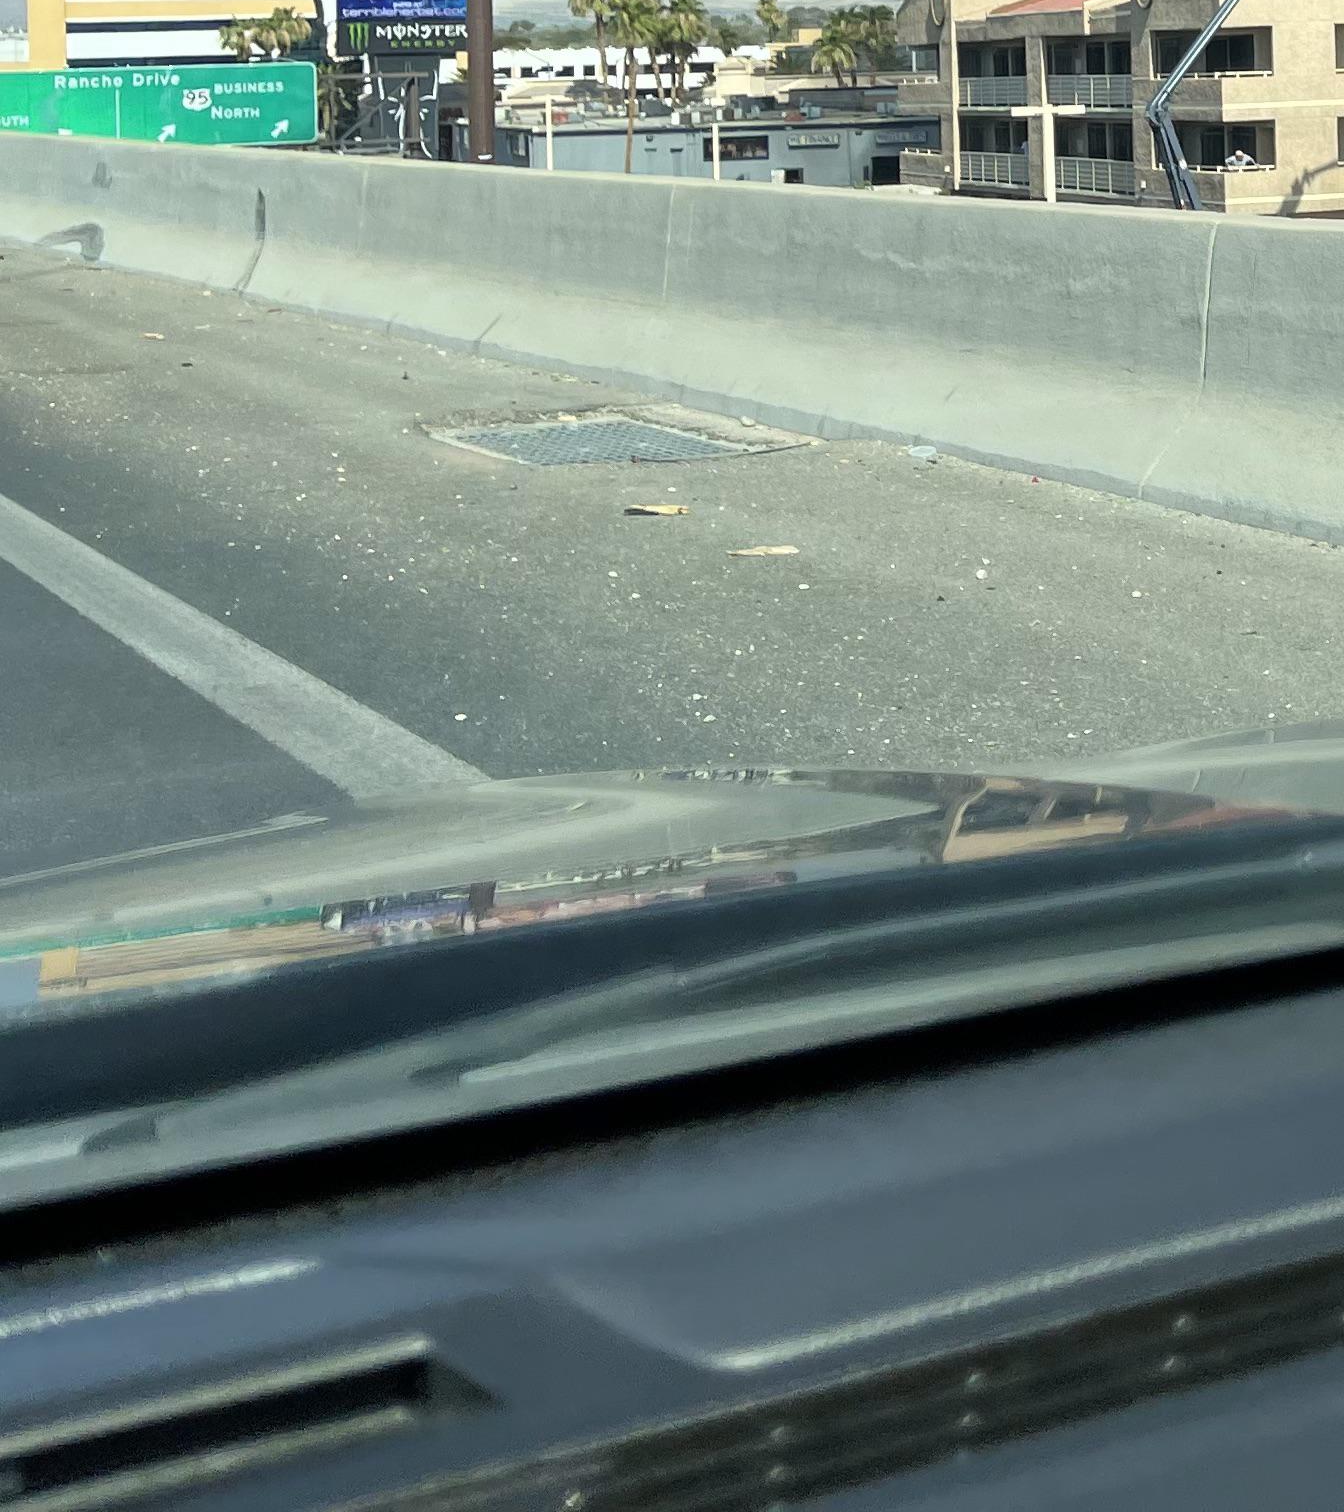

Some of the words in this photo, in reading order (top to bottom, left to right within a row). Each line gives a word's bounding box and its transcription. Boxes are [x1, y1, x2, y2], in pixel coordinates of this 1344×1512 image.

[375, 22, 469, 40] MONSTER
[54, 74, 123, 90] Rancho
[132, 73, 181, 87] Drive
[214, 81, 284, 94] BUSINESS
[186, 91, 209, 106] 95
[0, 115, 30, 128] UTH
